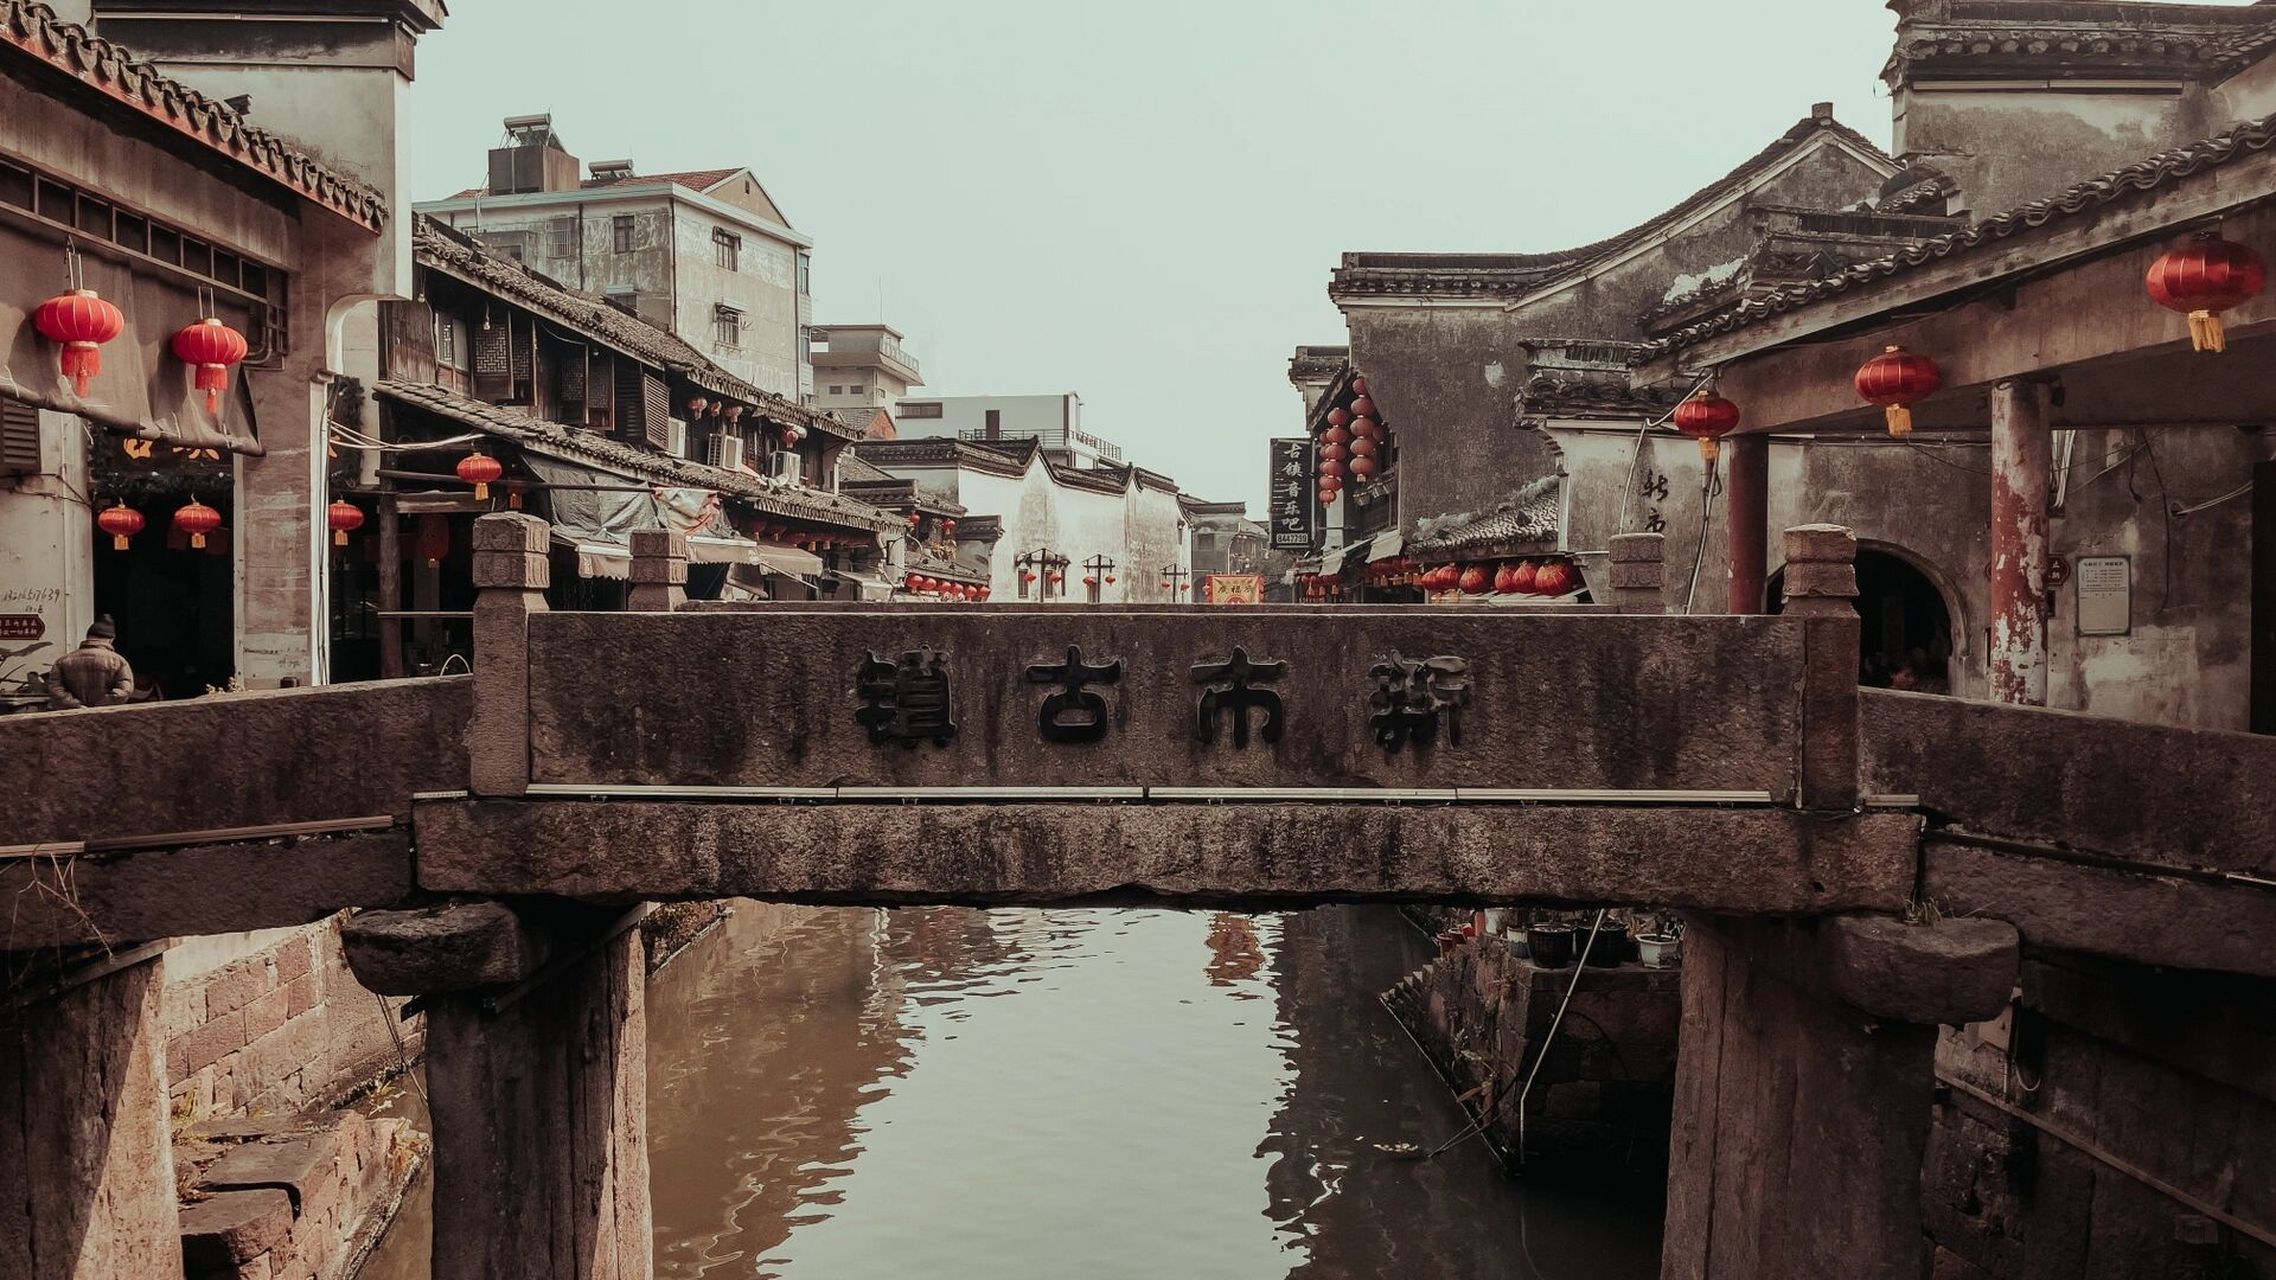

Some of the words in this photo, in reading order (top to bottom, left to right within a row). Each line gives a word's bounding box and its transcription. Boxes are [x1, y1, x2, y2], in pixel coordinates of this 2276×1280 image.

[1281, 443, 1304, 531] 古镇音乐吧
